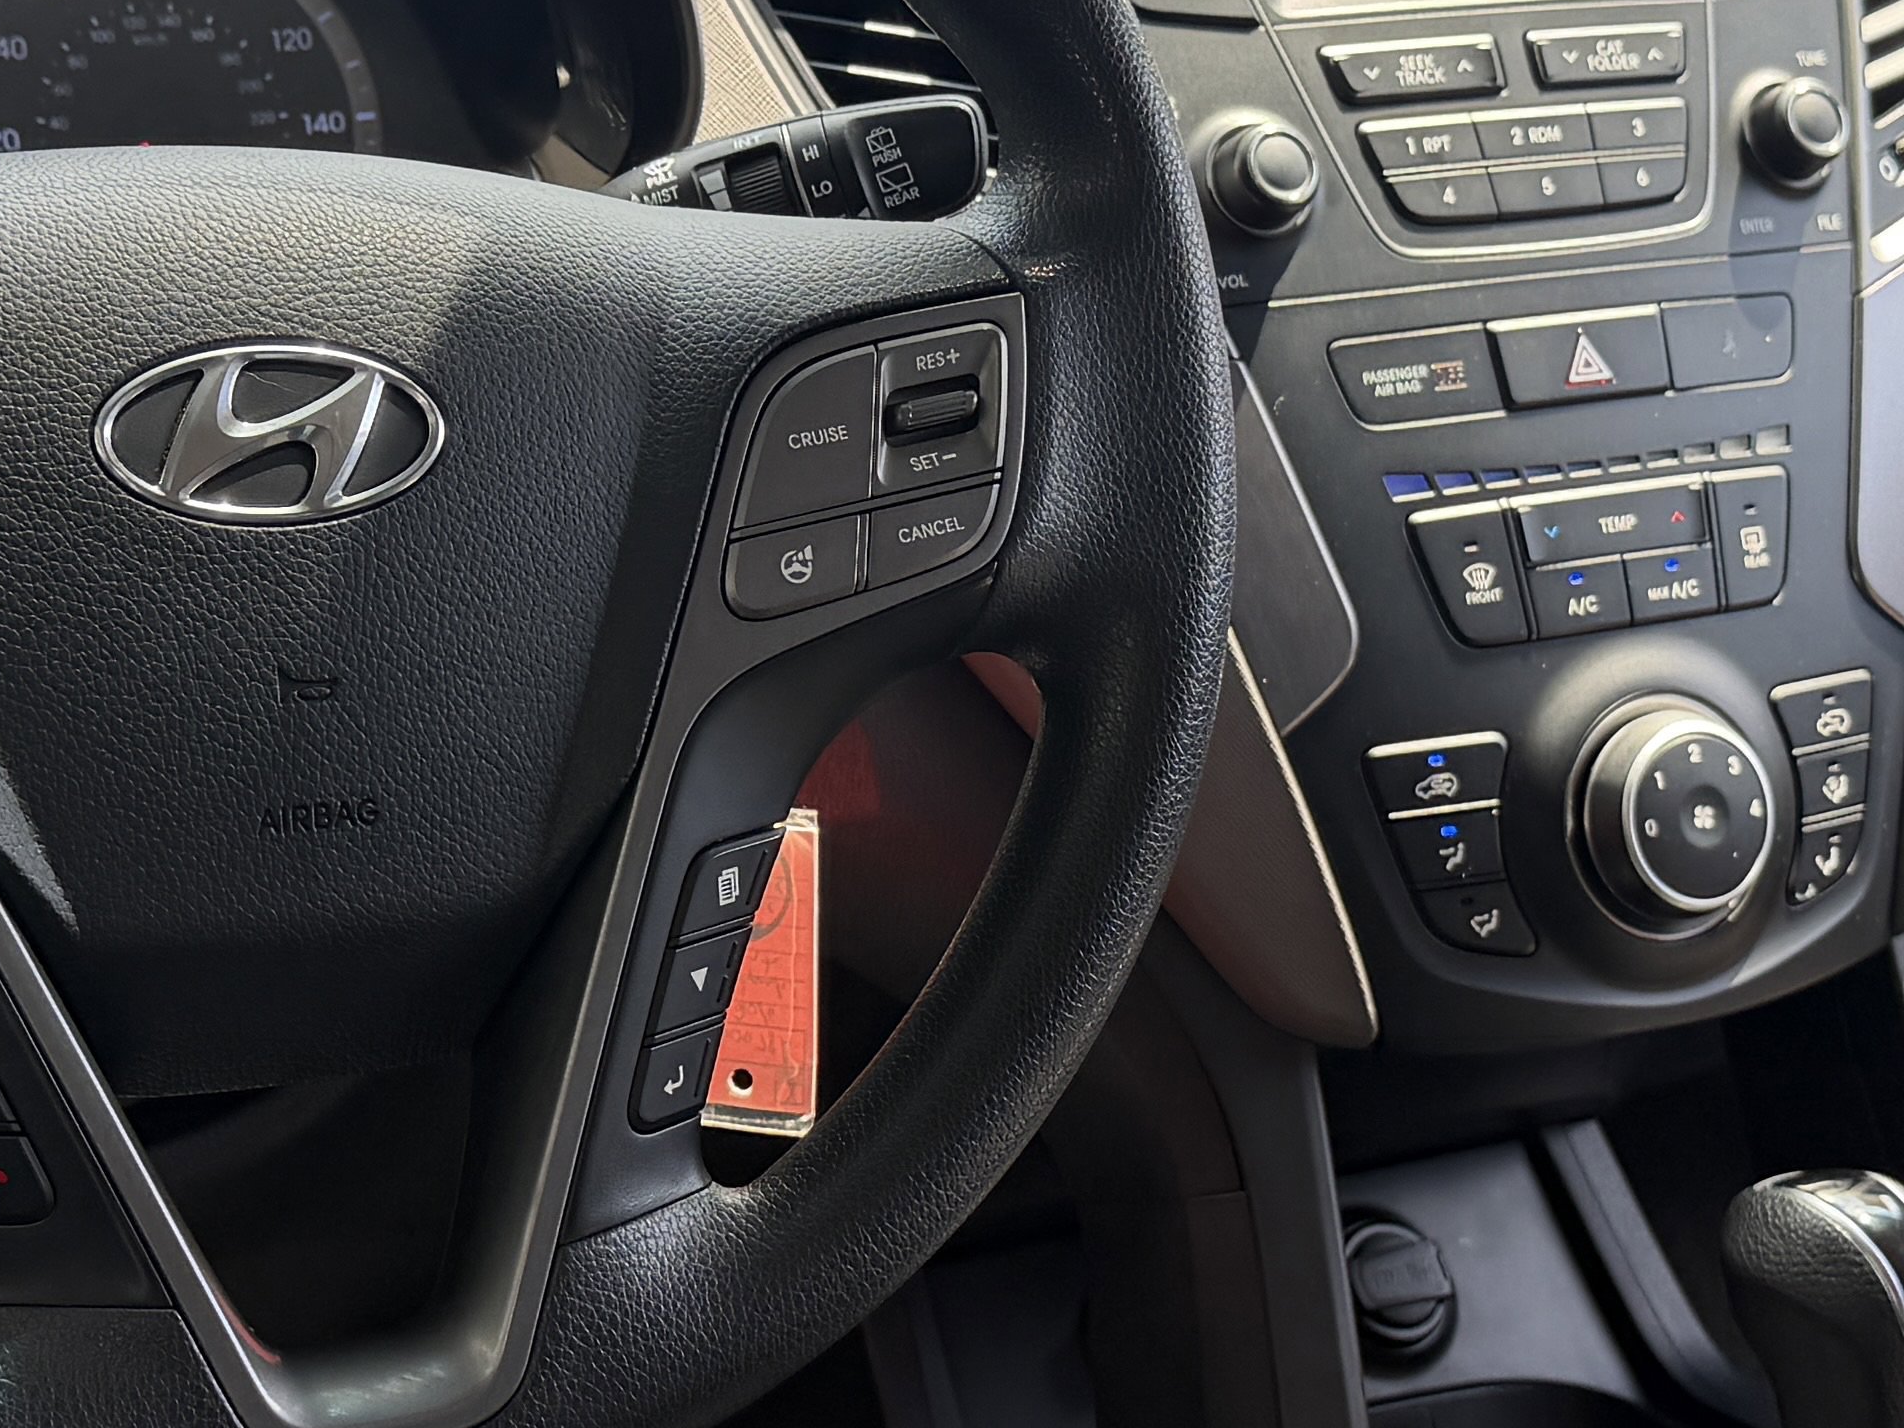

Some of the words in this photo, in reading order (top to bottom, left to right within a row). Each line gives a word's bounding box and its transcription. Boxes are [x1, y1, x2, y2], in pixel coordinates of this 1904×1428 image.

[271, 27, 313, 52] 120
[1399, 53, 1435, 71] SEEK
[1586, 53, 1641, 72] FOLDER
[1395, 67, 1447, 87] TRACK
[302, 111, 345, 136] 140
[1631, 116, 1646, 137] 3
[733, 134, 762, 149] INT
[1405, 136, 1417, 155] 1
[1422, 134, 1452, 154] RPT
[1510, 126, 1526, 146] 2
[1528, 124, 1564, 144] RDM
[802, 144, 820, 162] HI
[871, 146, 902, 168] PUSH
[646, 170, 678, 190] PULL
[1541, 175, 1556, 195] 5
[1636, 166, 1650, 186] 6
[642, 184, 679, 207] MIST
[810, 180, 833, 199] LO
[883, 186, 920, 209] REAR
[1442, 185, 1457, 205] 4
[1739, 217, 1775, 235] ENTER
[1217, 274, 1249, 290] VOL
[916, 348, 960, 372] RES+
[1362, 364, 1429, 386] PASSENGER
[1374, 380, 1395, 397] AIR
[1395, 378, 1423, 395] BAG
[788, 424, 849, 450] CRUISE
[898, 516, 965, 544] CANCEL
[1598, 513, 1639, 534] TEMP
[1464, 586, 1504, 606] FRONT
[1670, 578, 1703, 600] A/C
[1567, 594, 1600, 617] A/C
[1687, 743, 1703, 764] 2
[1727, 754, 1743, 776] 3
[1653, 770, 1666, 791] 1
[257, 796, 380, 839] AIRBAG
[1644, 818, 1659, 838] 0
